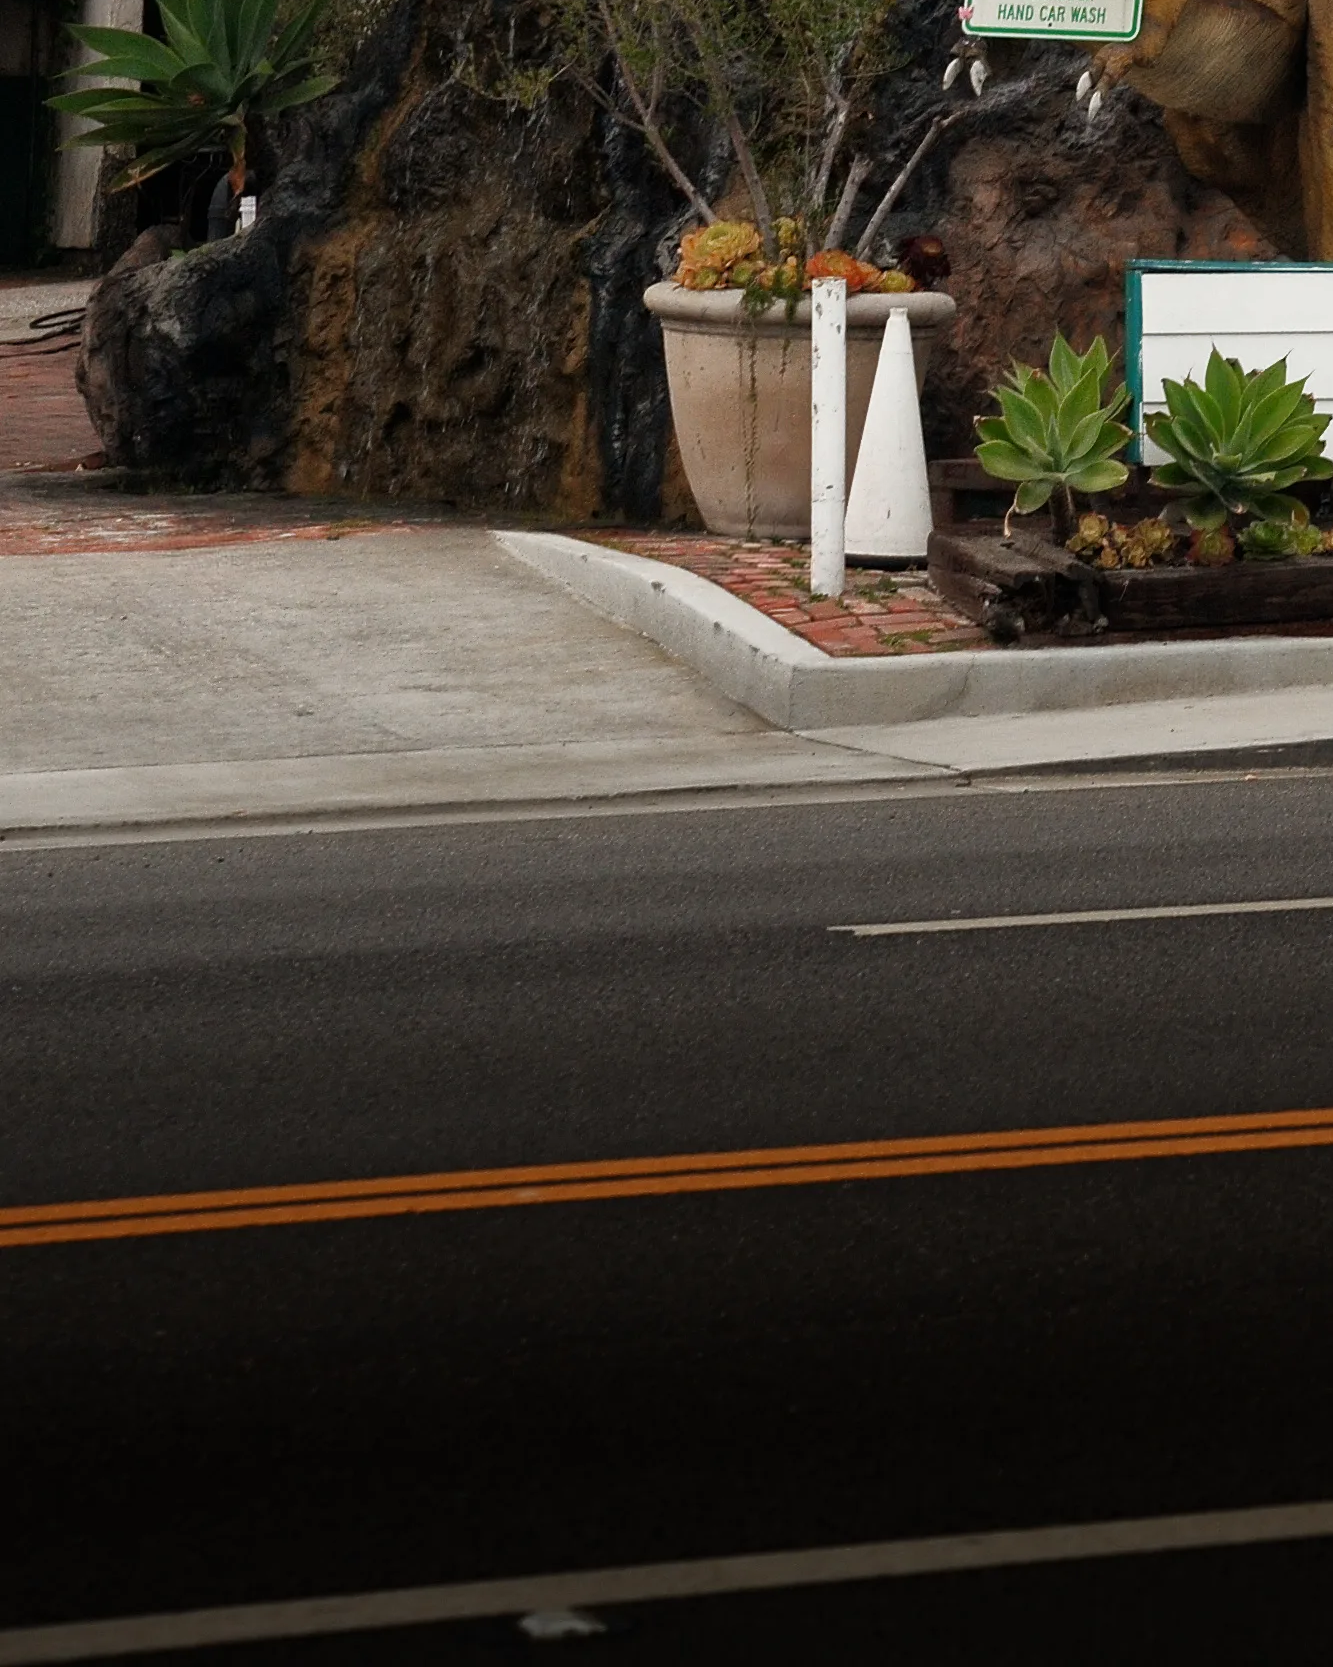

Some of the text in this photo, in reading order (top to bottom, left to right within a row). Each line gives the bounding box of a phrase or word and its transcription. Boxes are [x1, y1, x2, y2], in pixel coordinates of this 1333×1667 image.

[997, 4, 1106, 24] HAND CAR WASH
